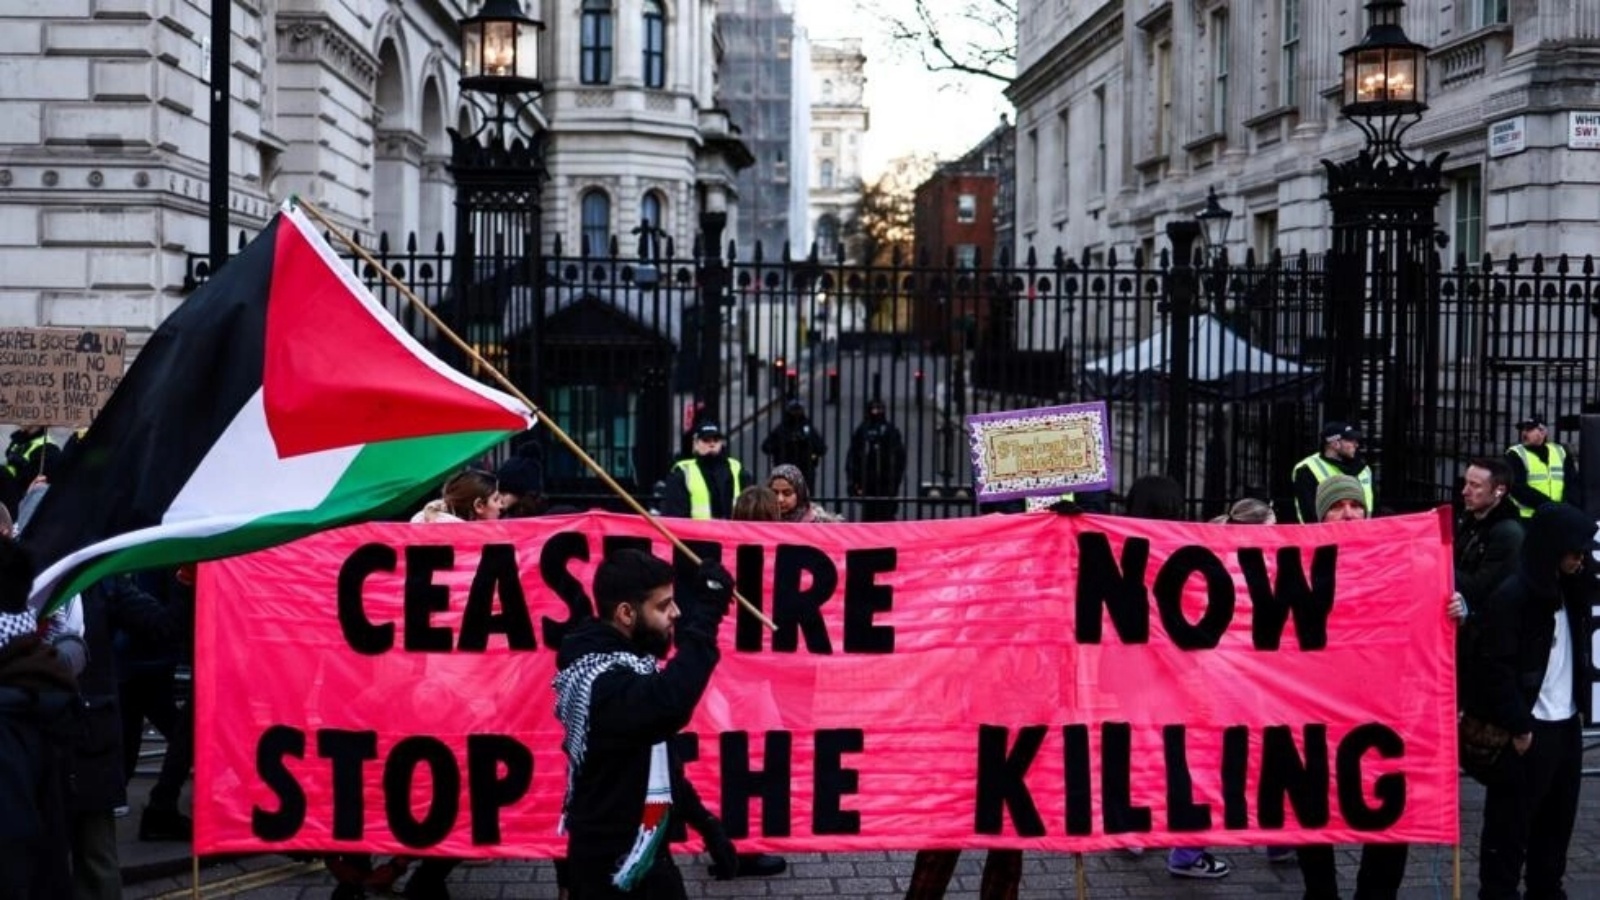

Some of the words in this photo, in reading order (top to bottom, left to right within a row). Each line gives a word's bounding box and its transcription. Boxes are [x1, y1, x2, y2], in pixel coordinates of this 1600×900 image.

[86, 356, 105, 373] NO
[1076, 532, 1338, 650] NOW
[252, 725, 534, 849] STOP
[975, 722, 1406, 837] KILLING
